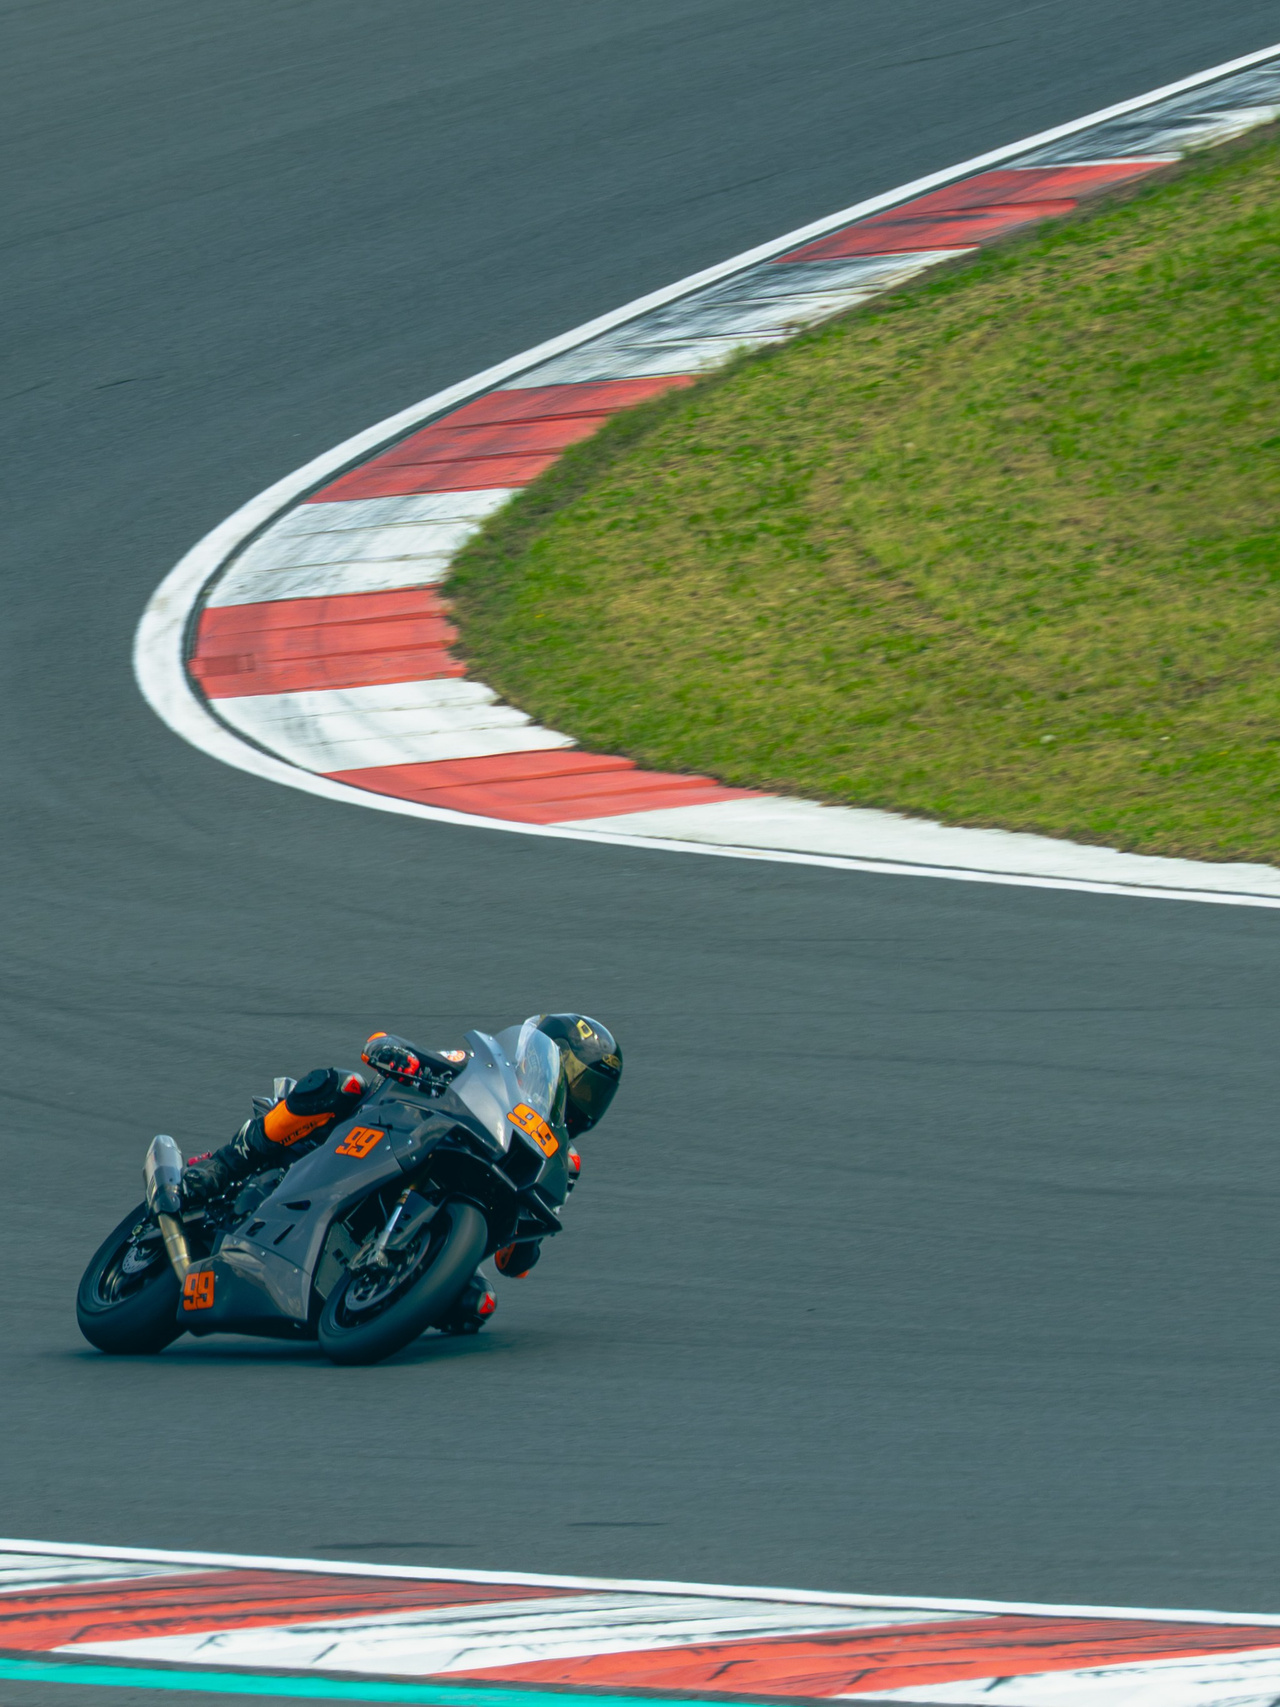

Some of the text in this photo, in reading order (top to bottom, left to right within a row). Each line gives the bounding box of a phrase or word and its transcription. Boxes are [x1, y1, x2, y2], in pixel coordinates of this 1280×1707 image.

[335, 1126, 385, 1159] 99
[506, 1102, 559, 1158] 99
[183, 1271, 215, 1311] 99
